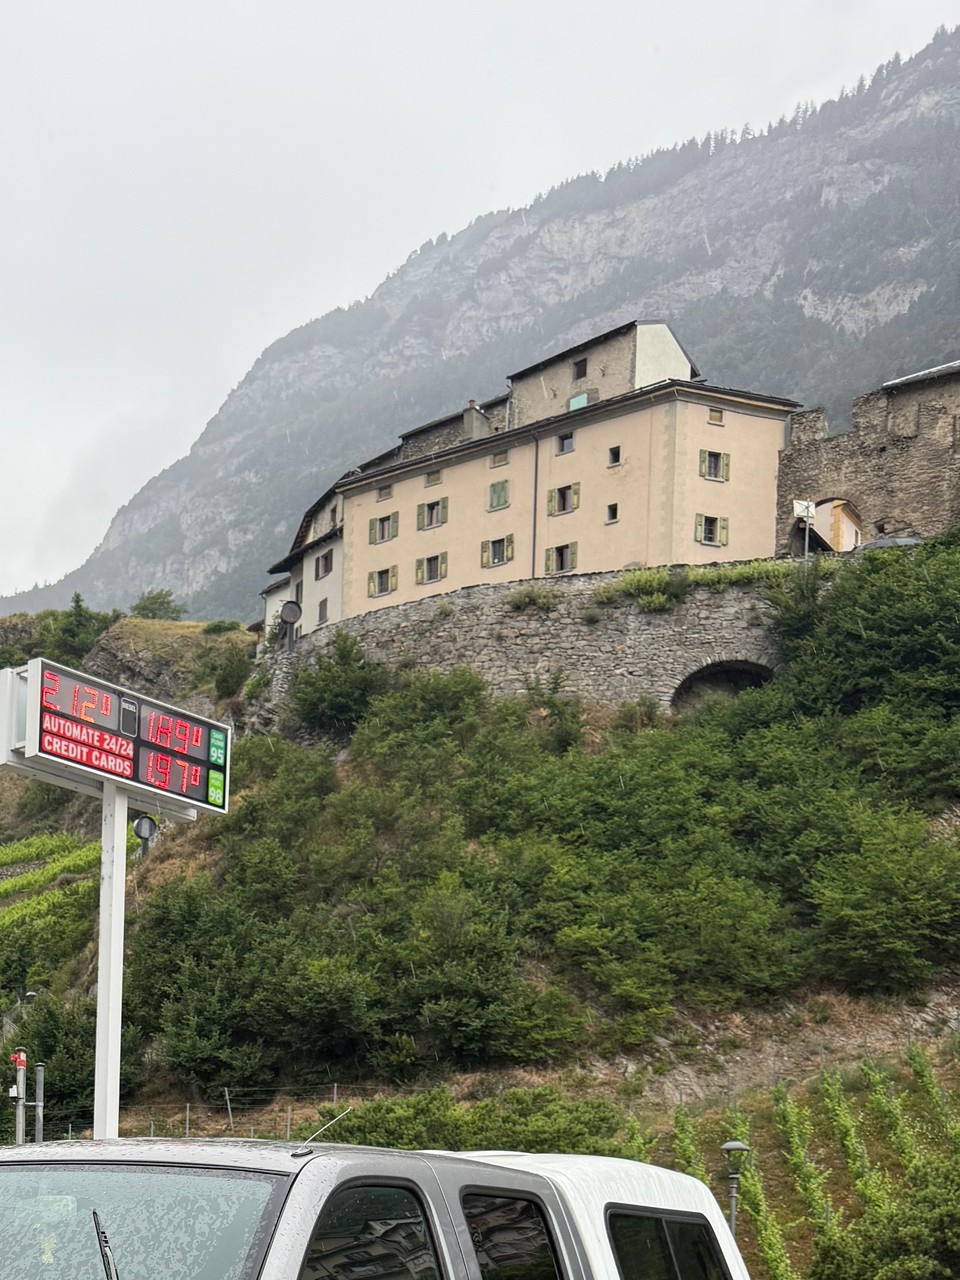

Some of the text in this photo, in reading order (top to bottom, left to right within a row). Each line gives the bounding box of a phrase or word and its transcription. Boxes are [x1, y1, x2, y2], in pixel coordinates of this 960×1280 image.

[43, 715, 134, 760] AUTOMATE 24/24
[44, 735, 132, 777] CREDIT CARDS
[210, 747, 224, 763] 95
[208, 786, 223, 803] 98
